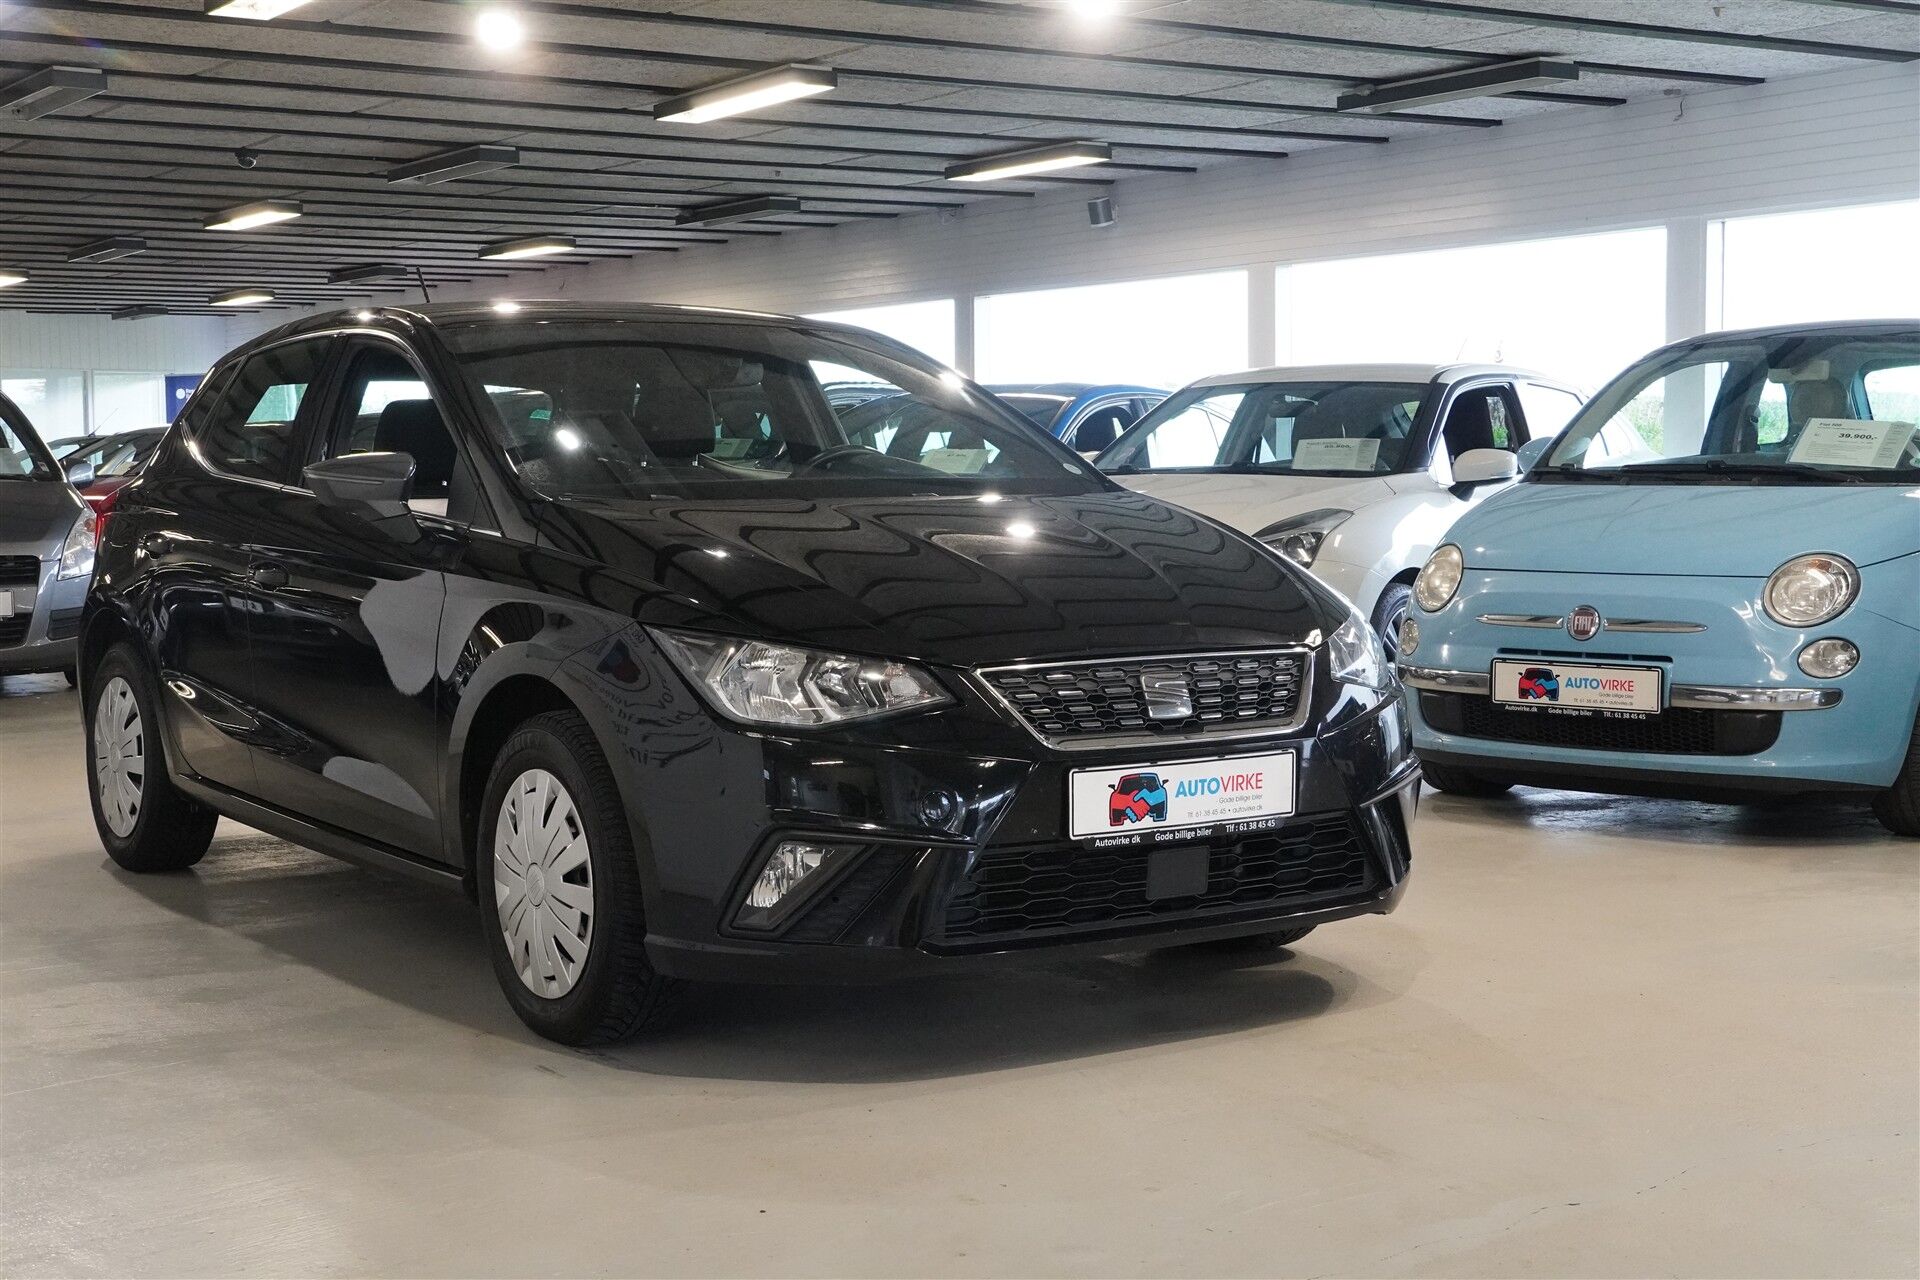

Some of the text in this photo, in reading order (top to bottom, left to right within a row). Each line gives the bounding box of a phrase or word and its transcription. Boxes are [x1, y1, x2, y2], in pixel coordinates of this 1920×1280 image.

[1574, 615, 1593, 631] FIAT
[1565, 676, 1634, 692] AUTOVIRKE
[1175, 772, 1263, 798] AUTOVIRKE
[1155, 832, 1174, 841] Gode
[1175, 829, 1196, 840] billige
[1197, 827, 1212, 837] biler
[1239, 822, 1248, 831] 61
[1248, 821, 1257, 830] 38
[1257, 820, 1266, 829] 45
[1267, 819, 1276, 827] 45
